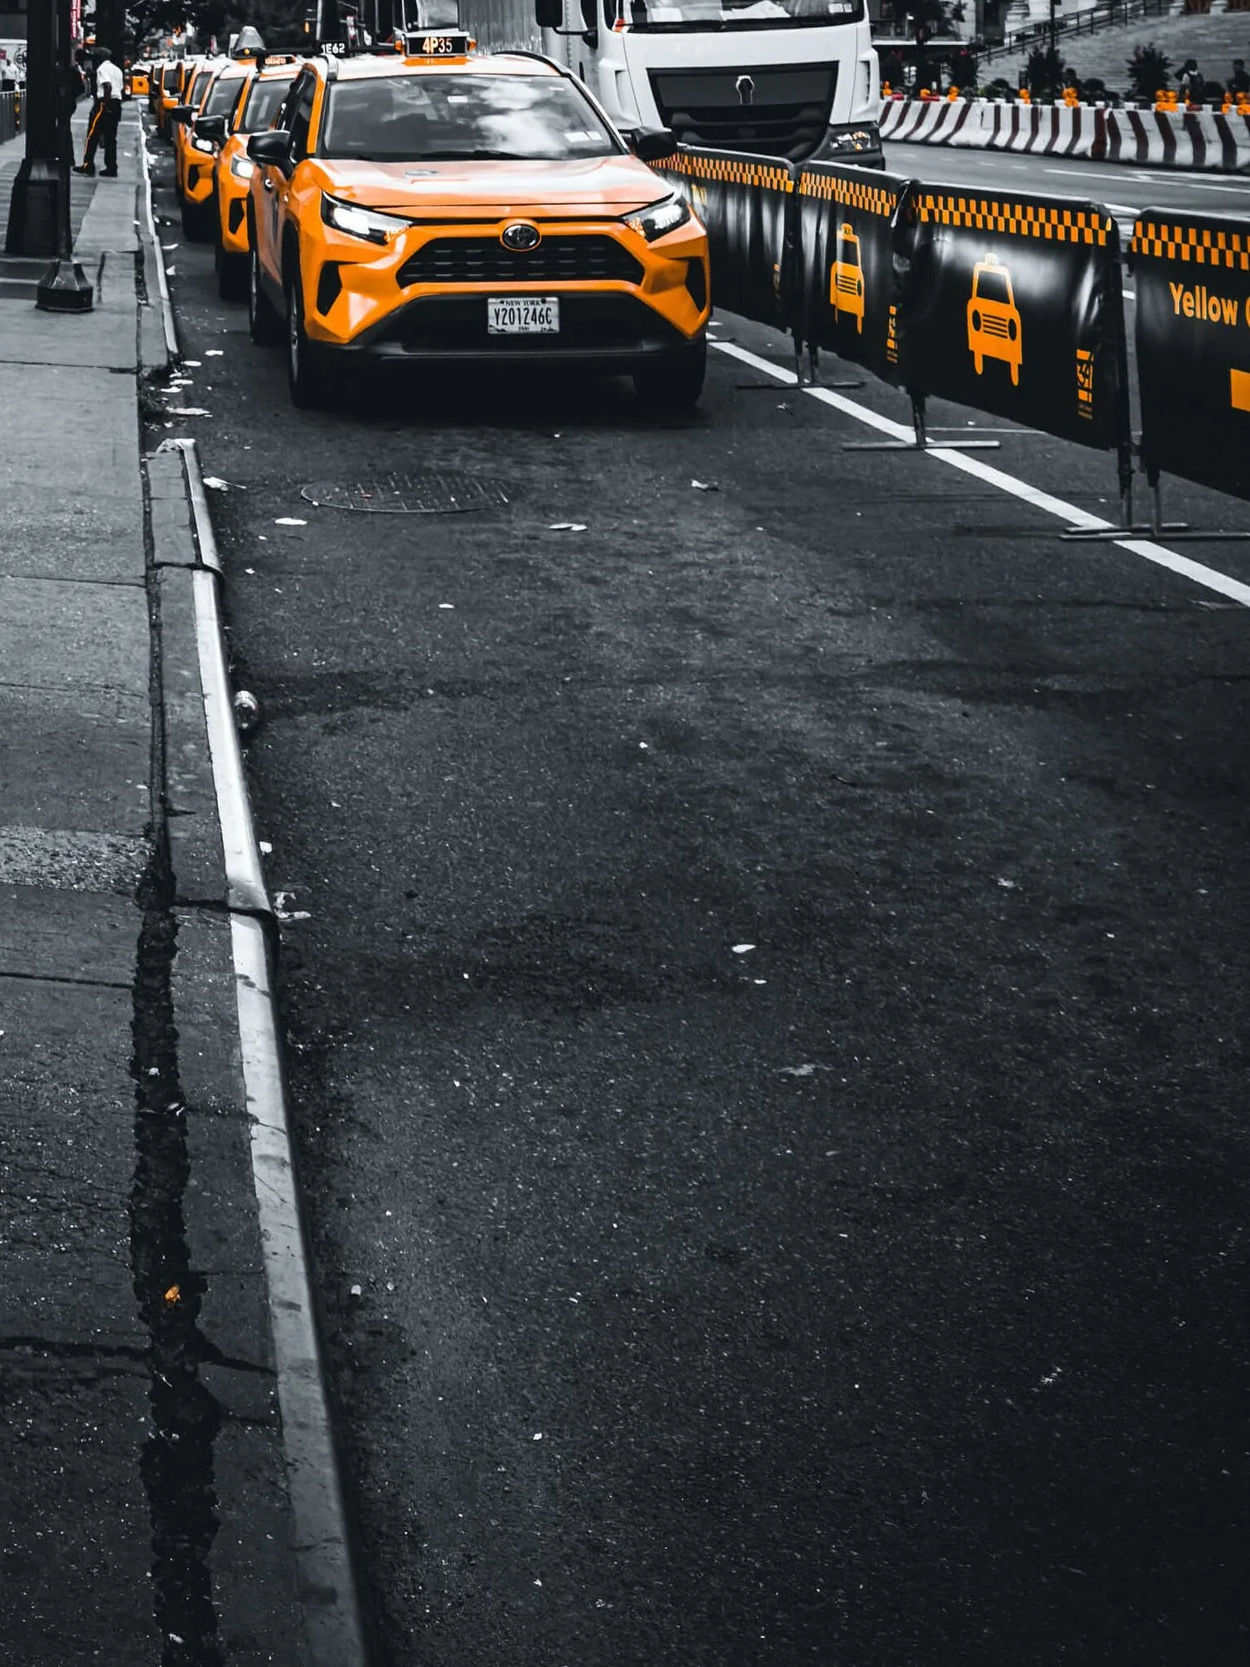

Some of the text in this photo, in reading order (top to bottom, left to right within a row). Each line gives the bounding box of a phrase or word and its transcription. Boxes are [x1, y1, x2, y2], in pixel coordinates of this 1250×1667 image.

[320, 43, 345, 54] 1E62
[422, 37, 453, 53] 4P35
[1168, 281, 1238, 326] Yellow
[493, 307, 552, 326] Y201246C
